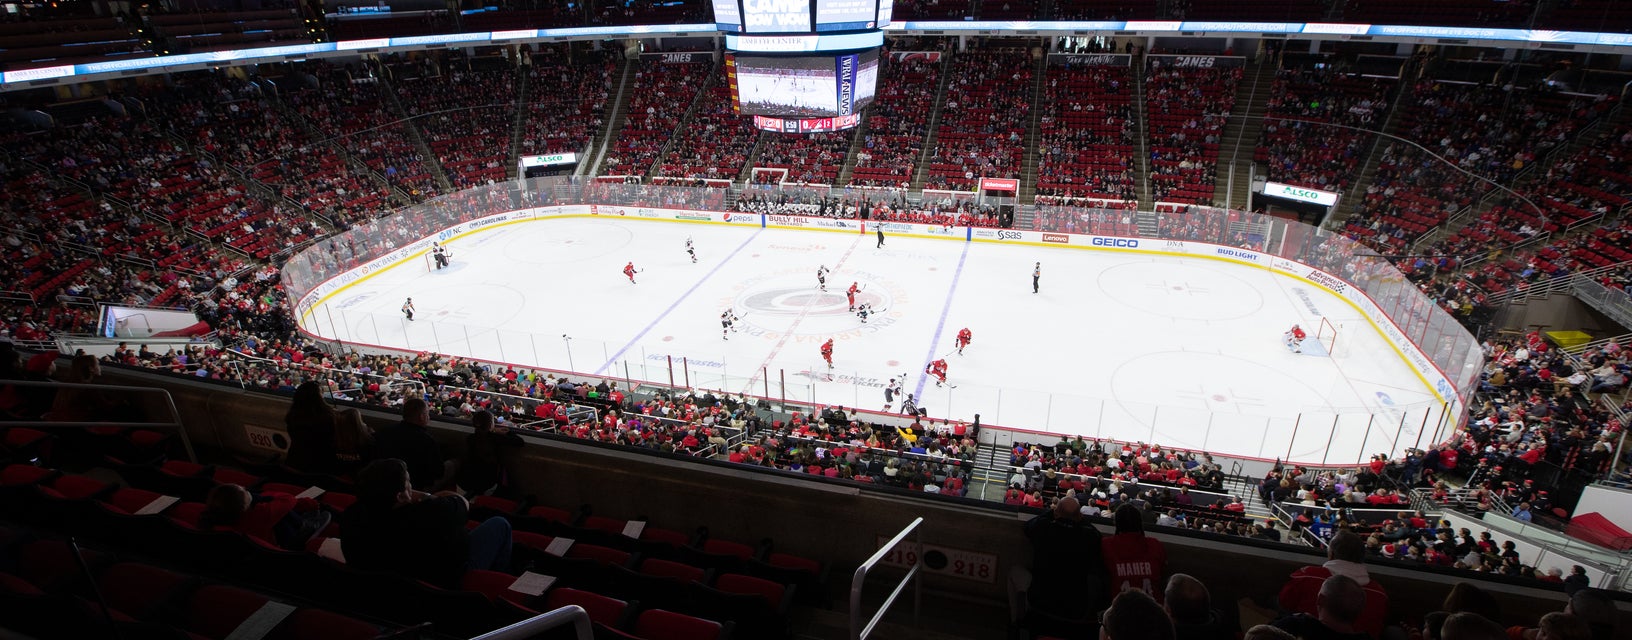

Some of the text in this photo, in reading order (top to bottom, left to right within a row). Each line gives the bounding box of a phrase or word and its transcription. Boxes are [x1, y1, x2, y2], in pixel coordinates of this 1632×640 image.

[662, 53, 692, 63] CANES
[1174, 56, 1216, 67] CANES
[841, 85, 851, 115] NEWS
[733, 214, 753, 223] pepsi
[769, 214, 810, 225] BULLY HILL
[1004, 231, 1022, 240] sas
[1044, 235, 1067, 243] Lenovo
[1092, 237, 1139, 248] GEICO
[1217, 248, 1258, 261] BUD LIGHT
[1310, 270, 1338, 285] Advance
[249, 432, 272, 448] 220
[883, 549, 918, 567] 219
[954, 560, 990, 578] 218
[1116, 561, 1153, 577] MAHER
